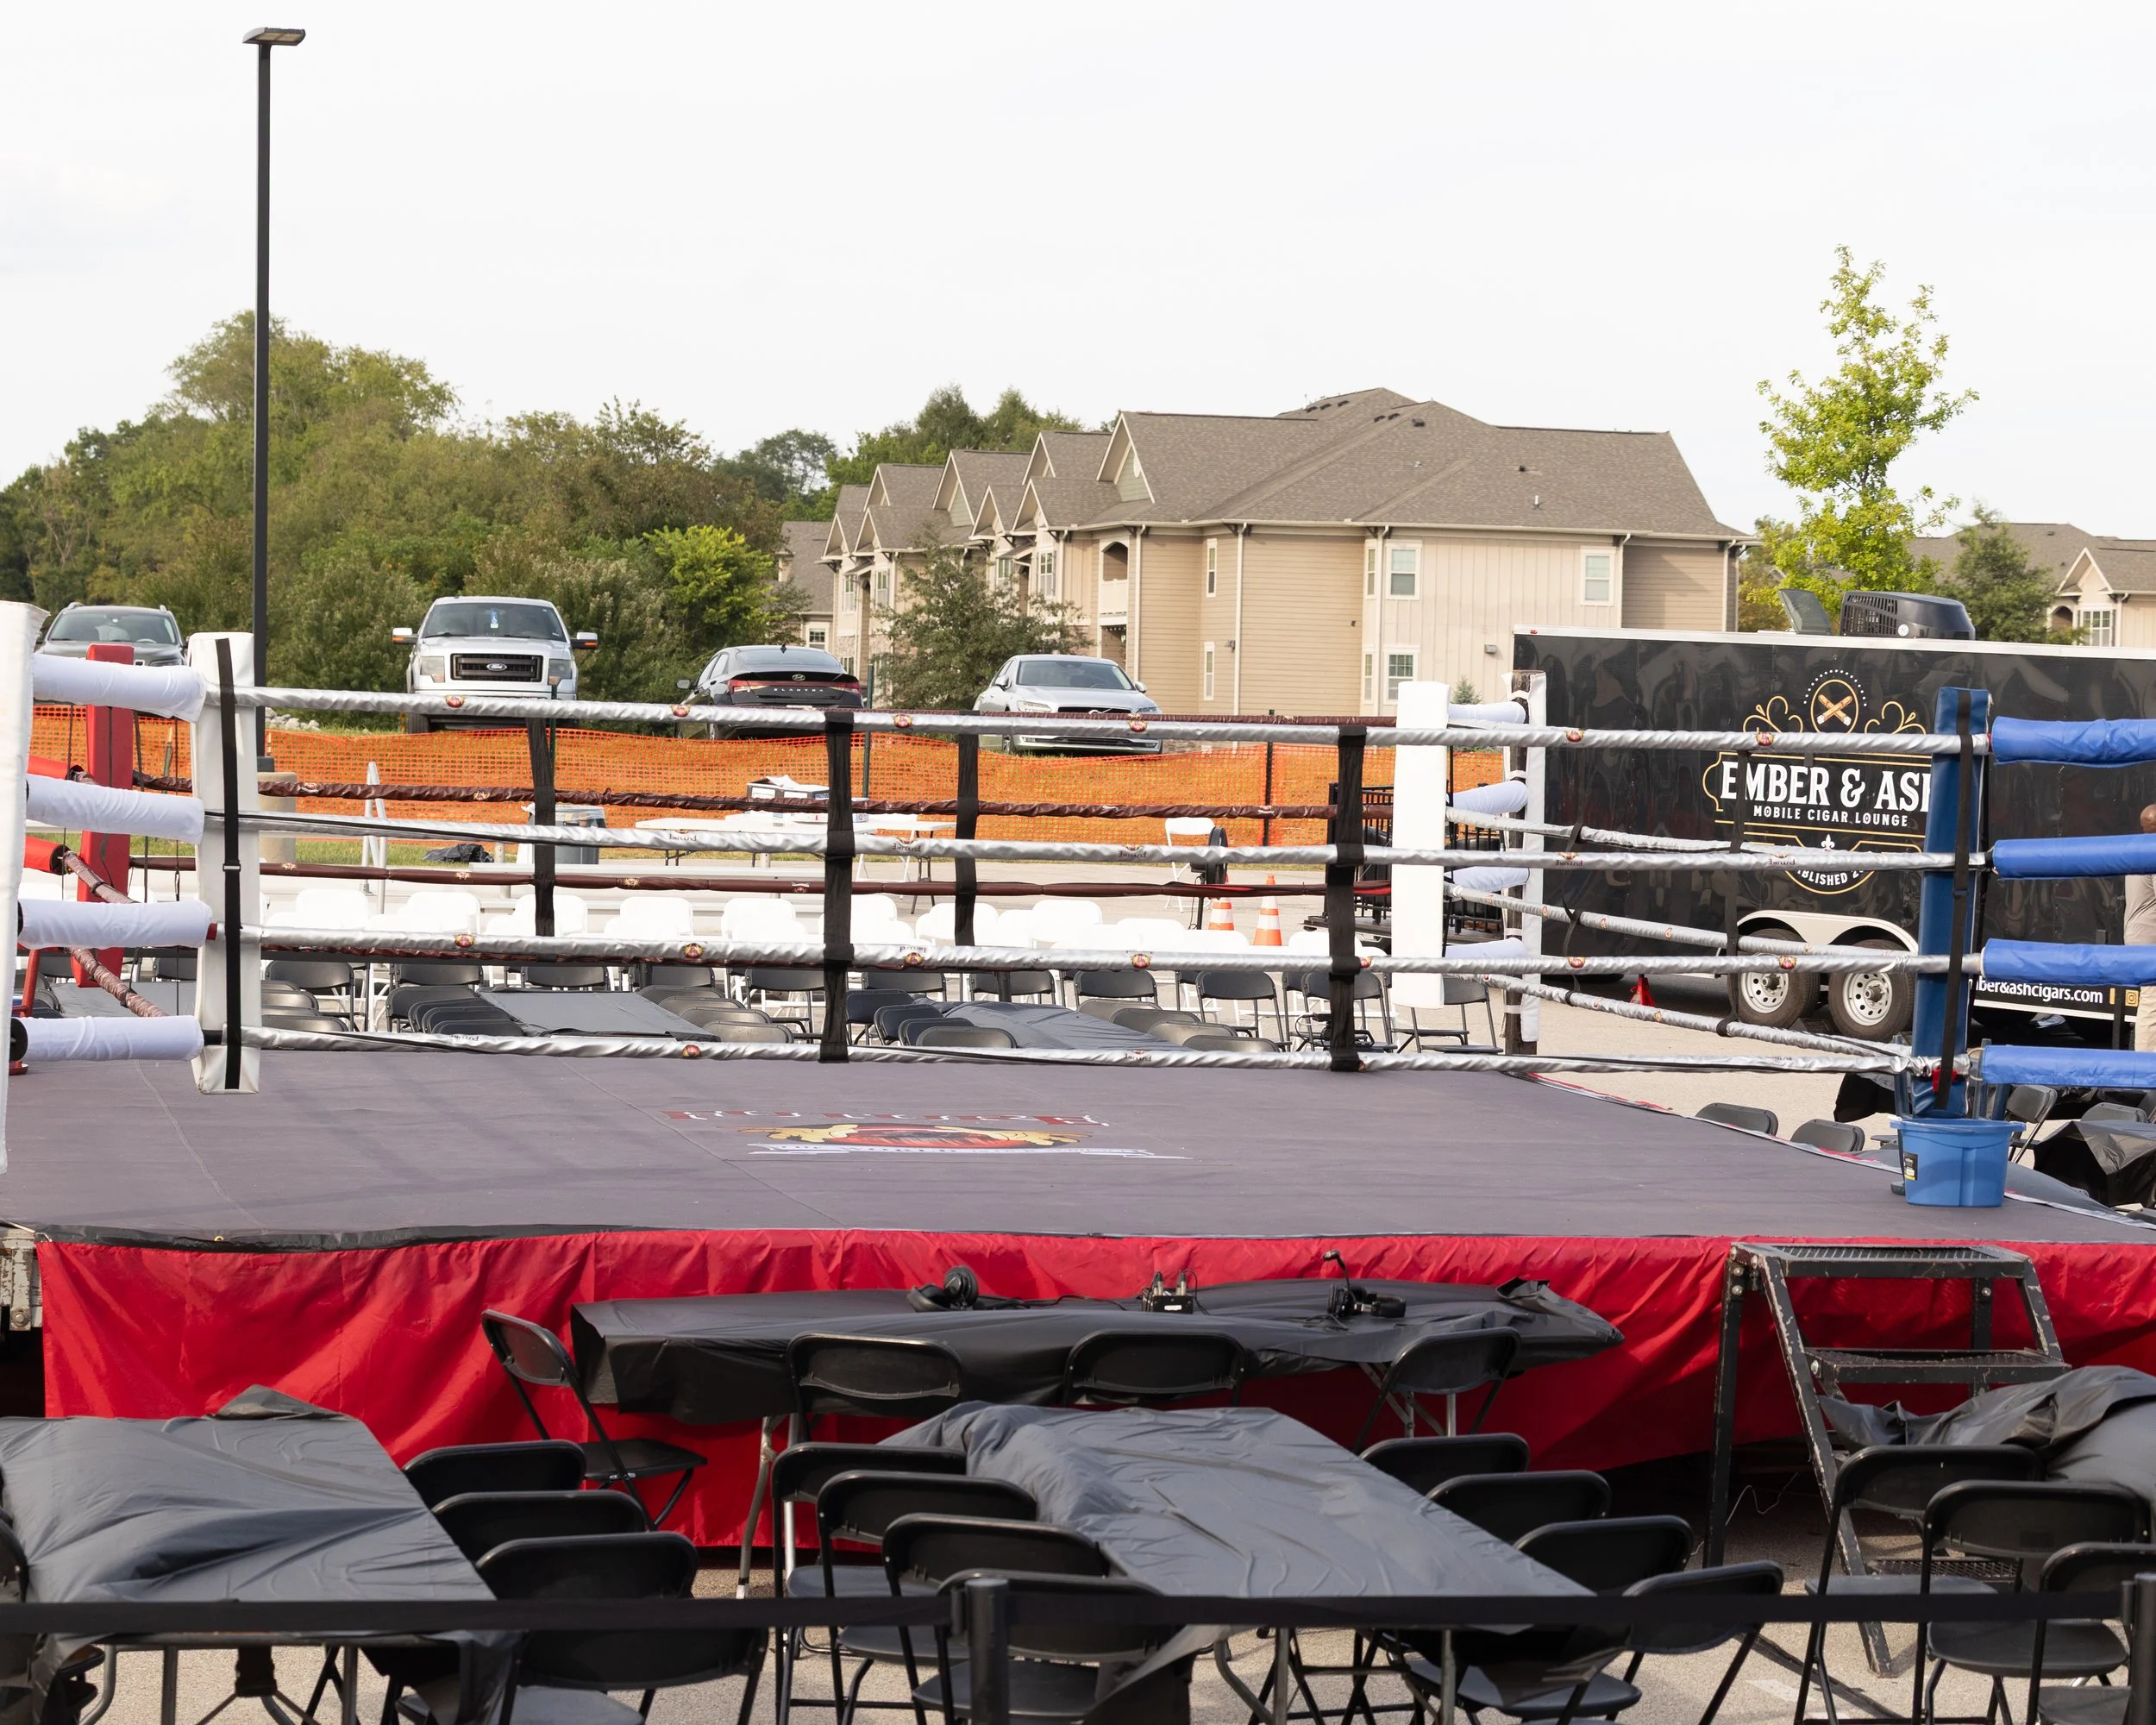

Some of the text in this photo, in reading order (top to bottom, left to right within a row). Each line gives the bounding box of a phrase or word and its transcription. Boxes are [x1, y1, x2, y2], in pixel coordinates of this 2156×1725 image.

[1720, 761, 1831, 806] EMBER
[1839, 768, 1866, 808] &
[1753, 805, 1908, 827] MOBILE CIGAR LOUNGE
